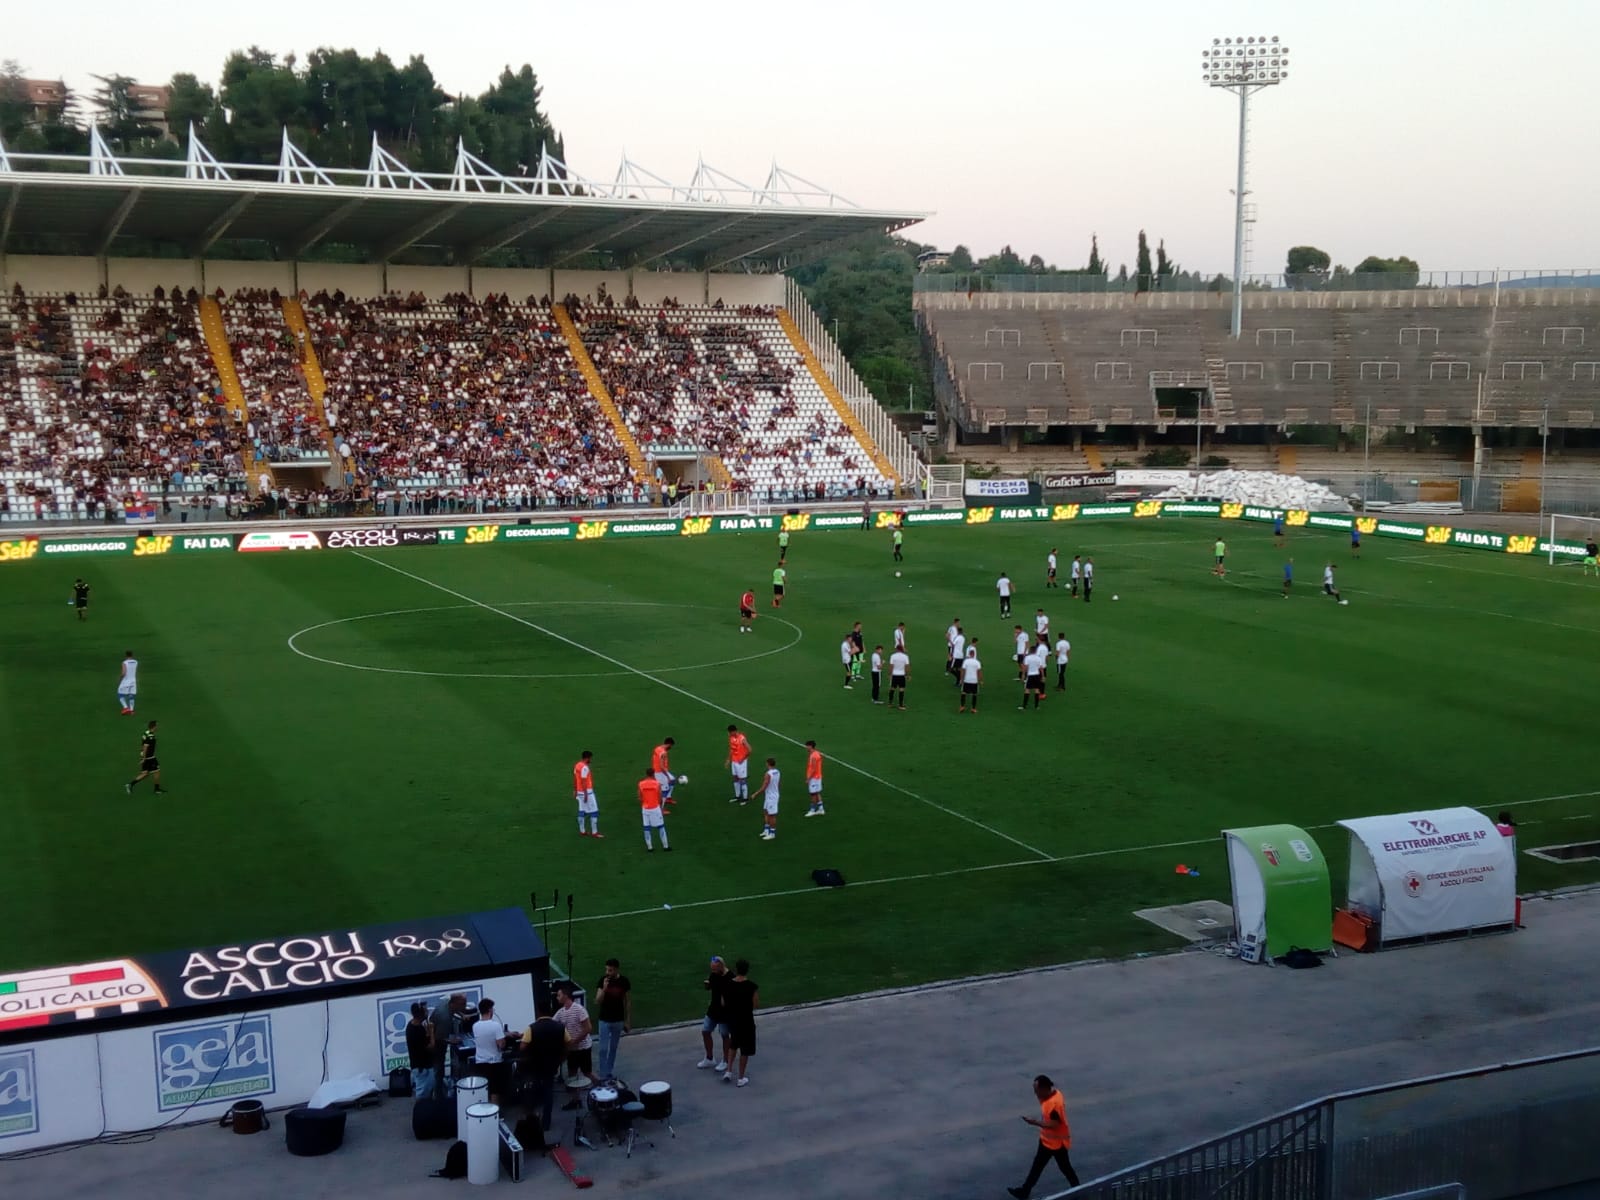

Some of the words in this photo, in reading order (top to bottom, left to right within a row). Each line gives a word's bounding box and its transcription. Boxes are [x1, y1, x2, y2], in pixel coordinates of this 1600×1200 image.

[979, 481, 1027, 489] PICENA
[1046, 475, 1082, 489] Grafiche
[1083, 473, 1115, 486] Tacconi
[966, 507, 995, 524] Self
[1001, 509, 1016, 519] FAI
[1018, 508, 1032, 518] DA
[1036, 508, 1049, 517] TE
[1053, 503, 1080, 520] Self
[1134, 500, 1162, 517] Self
[1220, 502, 1244, 518] Self
[1246, 509, 1259, 517] FAI
[1260, 510, 1272, 519] DA
[681, 515, 713, 535] Self
[720, 519, 738, 529] FAI
[740, 519, 757, 529] DA
[759, 518, 773, 528] TE
[781, 513, 810, 530] Self
[876, 512, 900, 528] Sel
[908, 512, 964, 522] GIARDINAGGIO
[1286, 510, 1309, 525] Self
[1356, 517, 1377, 533] Self
[327, 529, 397, 540] ASCOLI
[438, 530, 456, 540] TE
[465, 525, 499, 543] Self
[506, 527, 570, 538] DECORAZIONE
[576, 522, 608, 540] Self
[613, 522, 676, 533] GIARDINAGGIO
[1425, 526, 1452, 543] Self
[44, 541, 127, 553] GIARDINAGGIO
[134, 536, 173, 555] Self
[183, 538, 207, 550] FAI
[209, 537, 231, 549] DA
[327, 538, 399, 548] CALCIO
[1455, 531, 1472, 543] FAI
[1473, 534, 1490, 546] DA
[1491, 536, 1503, 547] TE
[1507, 535, 1537, 553] Self
[0, 541, 39, 559] Self
[1382, 831, 1472, 852] ELETTROMARCHE
[1474, 830, 1487, 841] AP
[180, 931, 365, 978] ASCOLI
[379, 929, 472, 958] 1898
[183, 956, 376, 1000] CALCIO
[51, 983, 146, 1006] CALCIO
[160, 1018, 269, 1090] gela
[214, 1078, 269, 1097] SURGELATI
